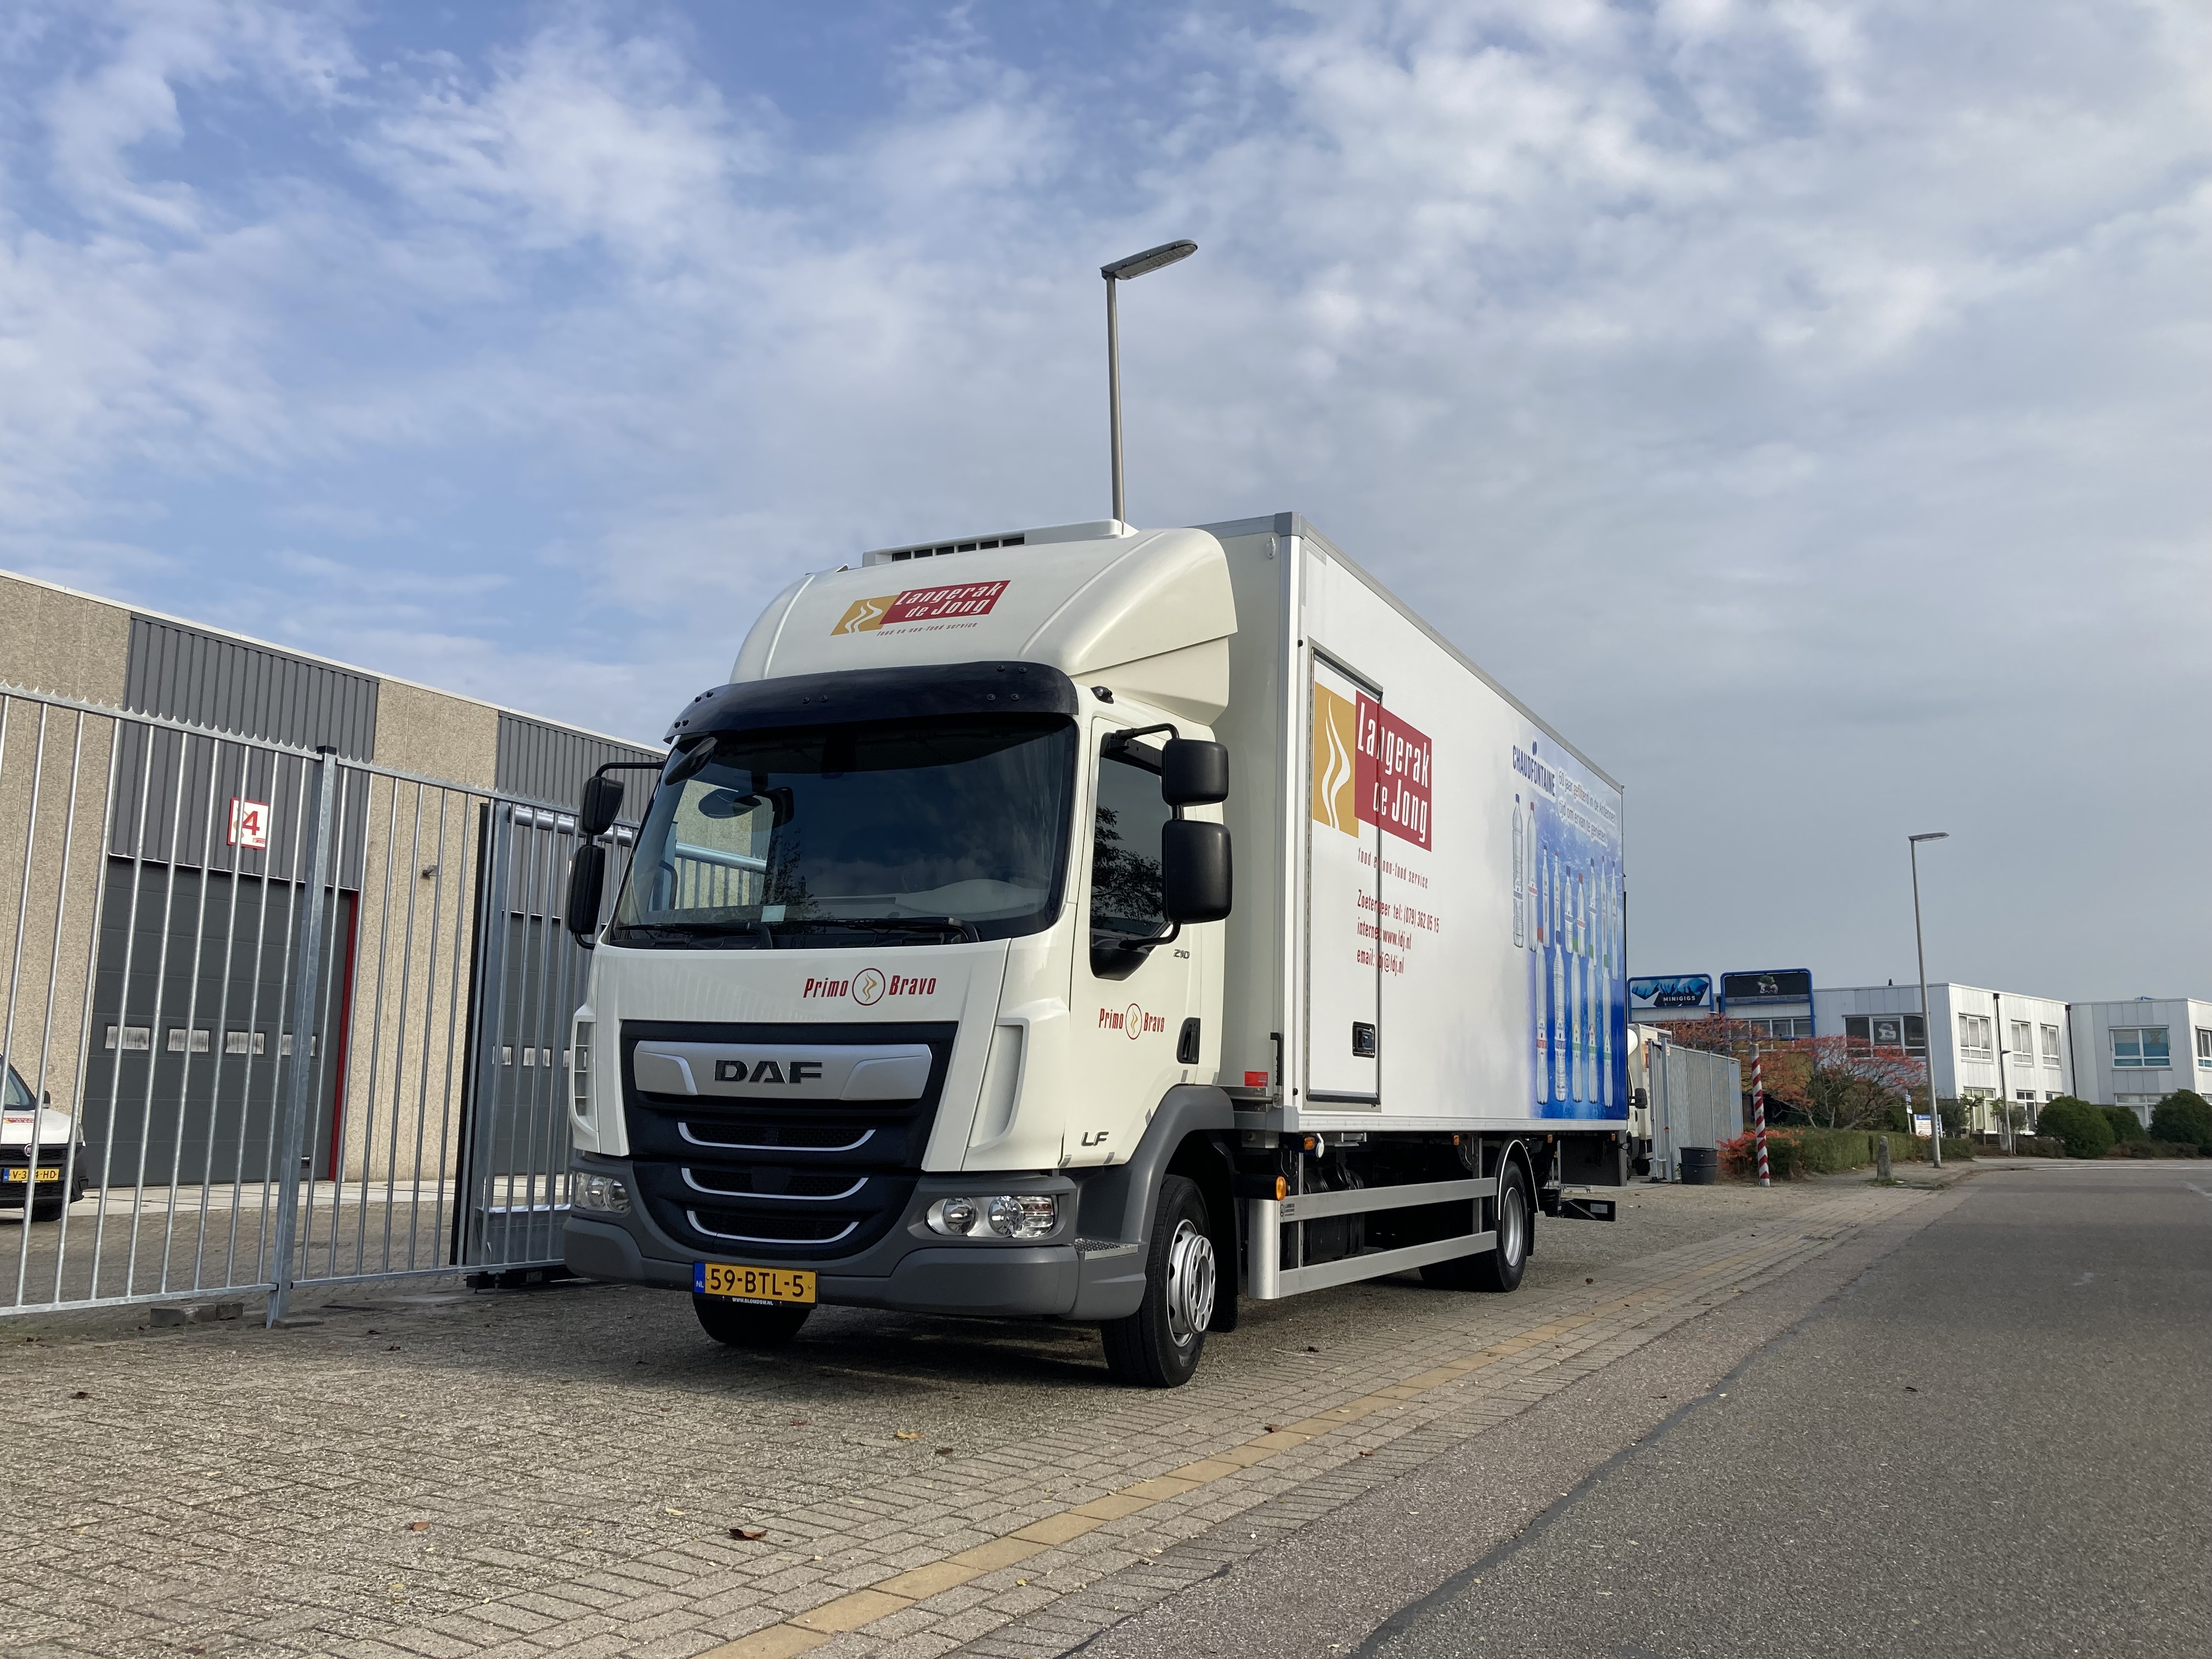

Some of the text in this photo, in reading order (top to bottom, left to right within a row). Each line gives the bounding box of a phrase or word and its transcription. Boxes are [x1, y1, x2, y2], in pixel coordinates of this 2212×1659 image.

[895, 582, 1003, 606] Langerak
[905, 599, 991, 618] de Jong
[908, 624, 944, 633] non-food
[1513, 744, 1555, 797] CHAUDFONTAINE
[1392, 779, 1427, 843] Jong
[241, 810, 261, 836] 4
[1358, 847, 1372, 866] food
[1383, 860, 1407, 881] non-food
[1408, 870, 1428, 889] service
[1393, 904, 1403, 922] tel:
[1404, 905, 1417, 928] (079)
[1417, 911, 1426, 929] 362
[1427, 913, 1433, 931] 05
[1434, 917, 1440, 933] 15
[1383, 929, 1412, 952] www.ldj.nl
[1173, 949, 1190, 960] 210
[1357, 947, 1375, 967] email:
[803, 975, 937, 998] Primo Bravo
[1098, 1008, 1165, 1032] Primo Bravo
[714, 1059, 823, 1084] DAF
[1081, 1131, 1109, 1146] LF
[13, 1170, 55, 1179] V-34-HD
[696, 1280, 704, 1288] NL
[710, 1268, 804, 1297] 59-BTL-5
